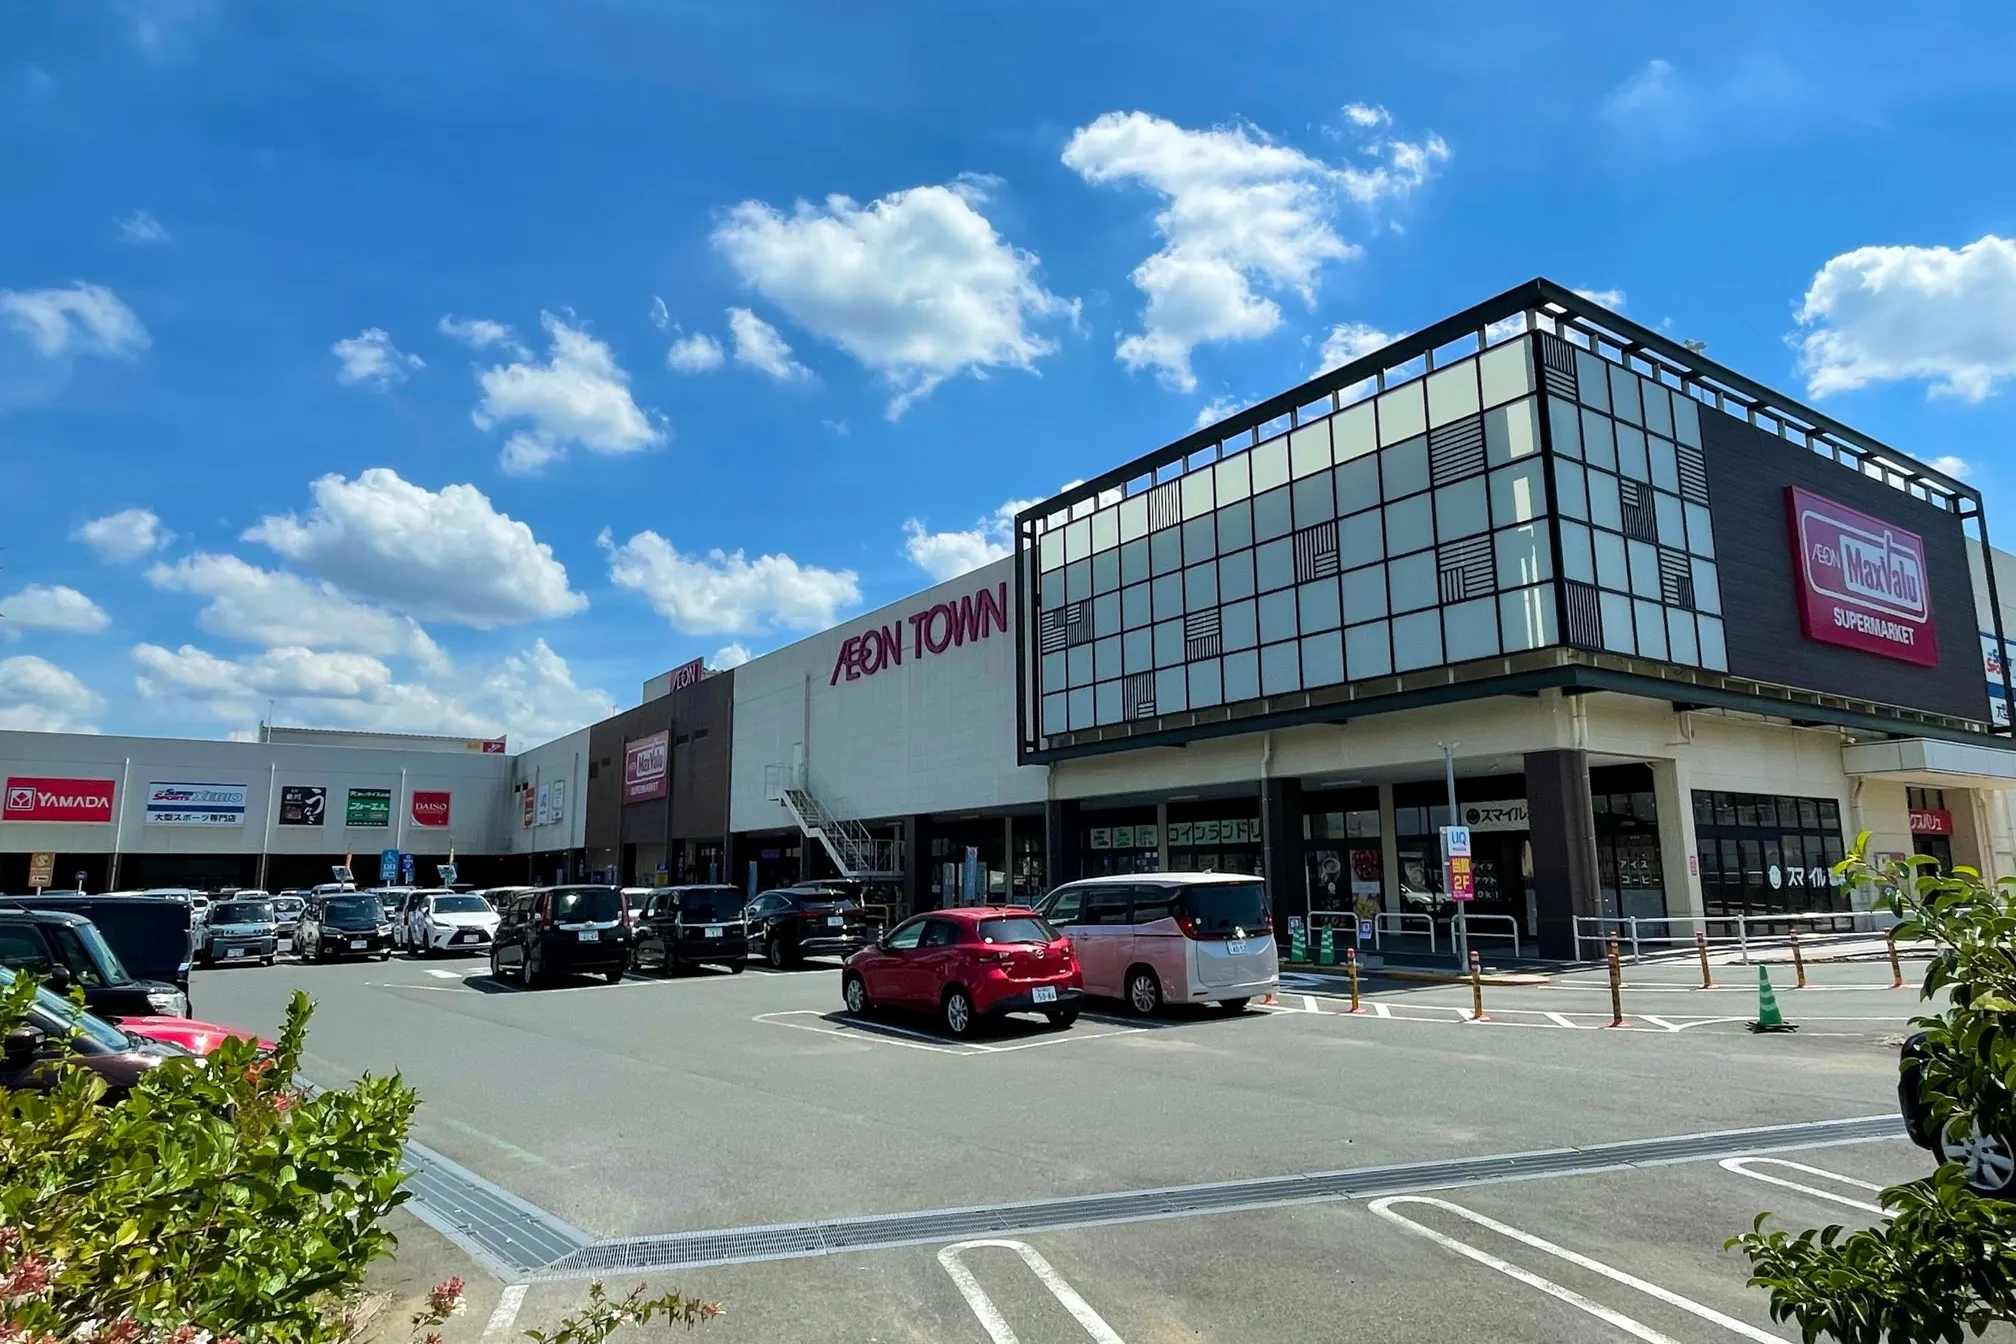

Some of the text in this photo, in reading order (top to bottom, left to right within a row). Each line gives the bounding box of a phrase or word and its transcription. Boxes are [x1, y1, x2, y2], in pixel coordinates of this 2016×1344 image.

[1844, 531, 1918, 603] MaxValu
[908, 582, 1007, 659] TOWN
[1833, 606, 1915, 646] SUPERMARKET
[37, 792, 110, 808] YAMADA
[415, 803, 448, 811] DAISO
[1481, 807, 1527, 822] スマイル
[1451, 831, 1467, 846] UQ
[1620, 860, 1648, 870] アイス
[1453, 875, 1470, 890] 2F
[1621, 875, 1660, 885] コーヒー
